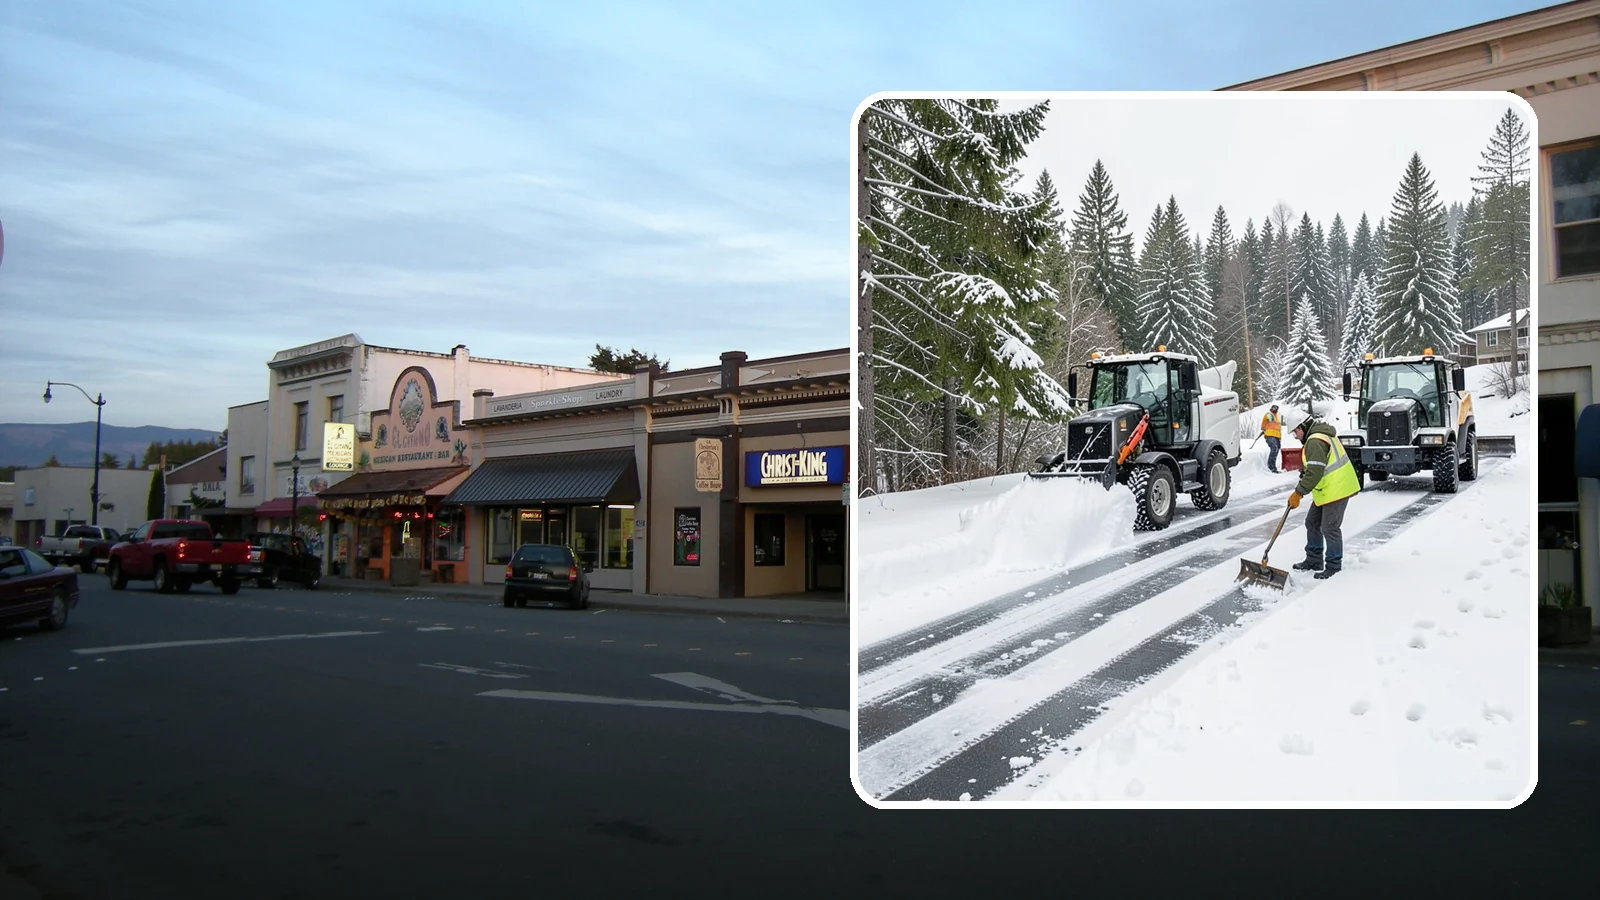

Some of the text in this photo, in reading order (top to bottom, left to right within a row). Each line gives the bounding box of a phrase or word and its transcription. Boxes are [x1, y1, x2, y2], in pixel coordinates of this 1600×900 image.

[531, 394, 582, 408] Sparkle Shop
[595, 389, 624, 400] LAUNDRY
[494, 402, 522, 412] LAVANDERIA
[392, 425, 401, 449] EL
[374, 454, 396, 464] MEXICAN
[398, 451, 433, 462] RESTAURANT
[438, 450, 450, 459] BAR
[761, 450, 827, 478] CHRIST KING
[697, 481, 722, 489] Coffee House
